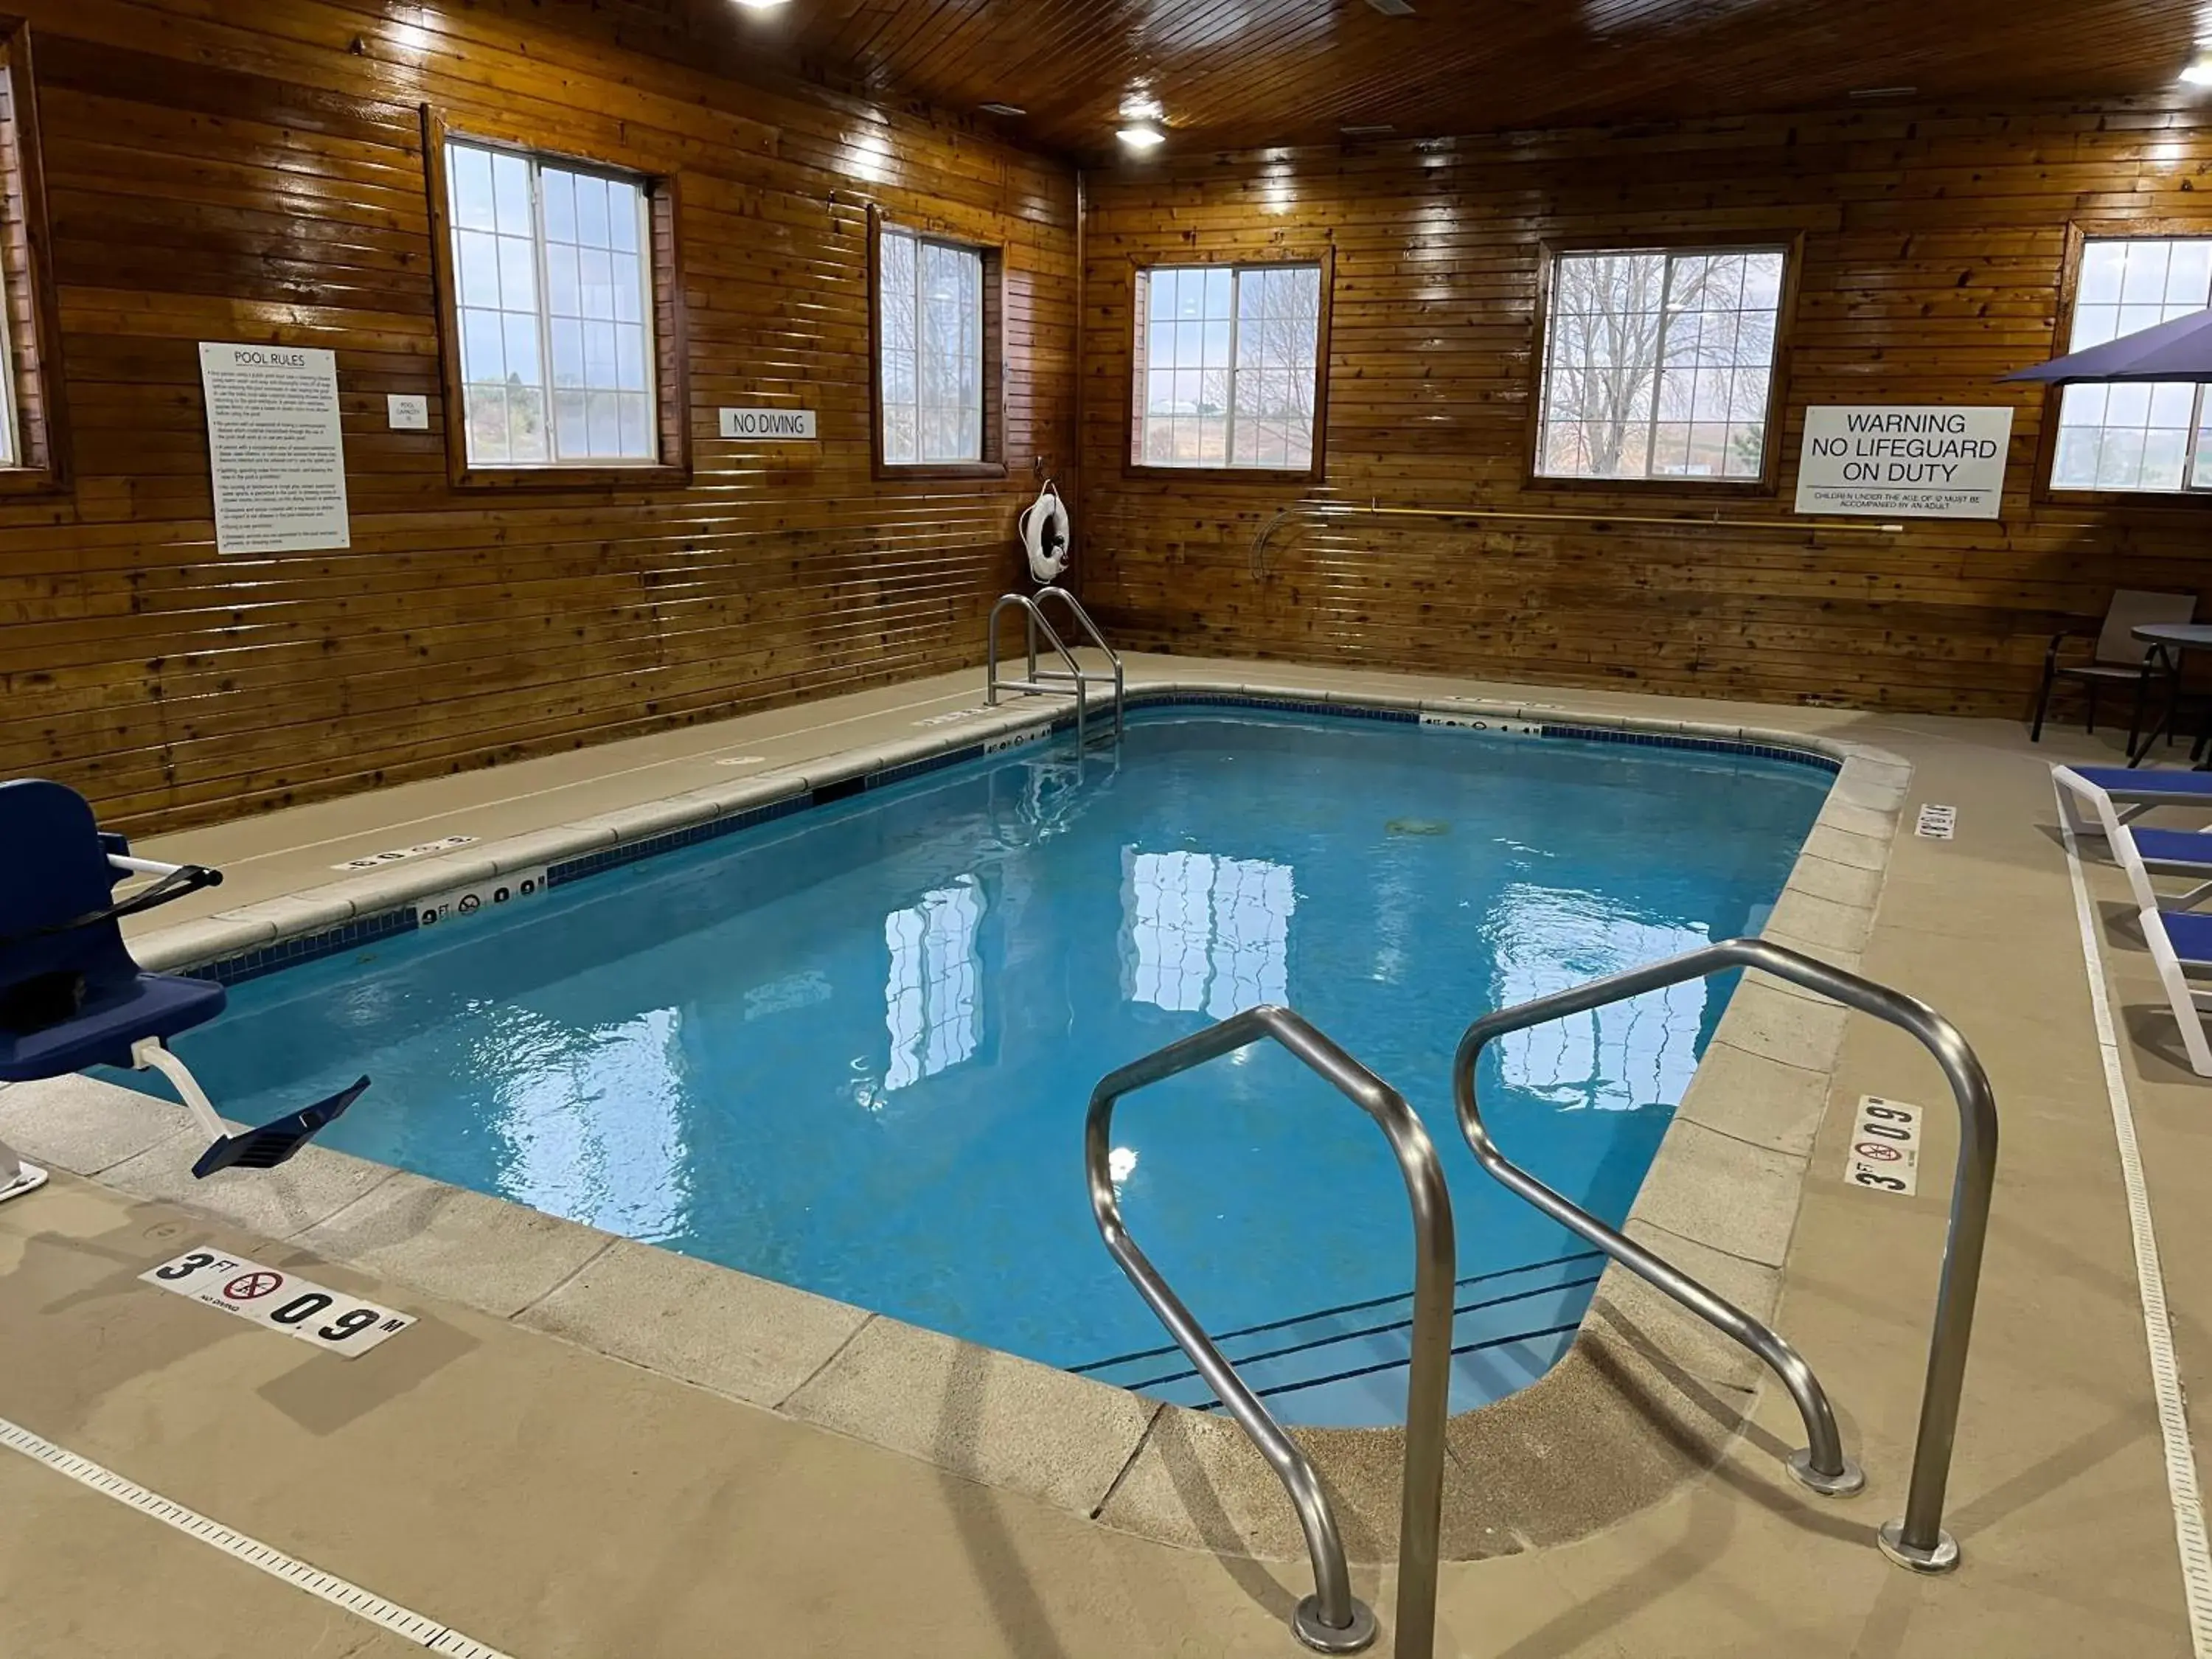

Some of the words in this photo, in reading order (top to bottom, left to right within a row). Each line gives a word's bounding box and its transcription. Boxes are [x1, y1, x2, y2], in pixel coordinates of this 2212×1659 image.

[234, 350, 268, 364] POOL
[271, 353, 305, 366] RULES
[734, 413, 756, 434] NO
[759, 414, 804, 434] DIVING
[1847, 414, 1965, 434] WARNING
[1812, 438, 1848, 456] NO
[1856, 438, 1997, 459] LIFEGUARD
[1843, 462, 1879, 481] ON
[1888, 463, 1958, 482] DUTY
[1855, 1172, 1906, 1190] 3
[156, 1253, 215, 1280] 3
[209, 1259, 240, 1273] FT
